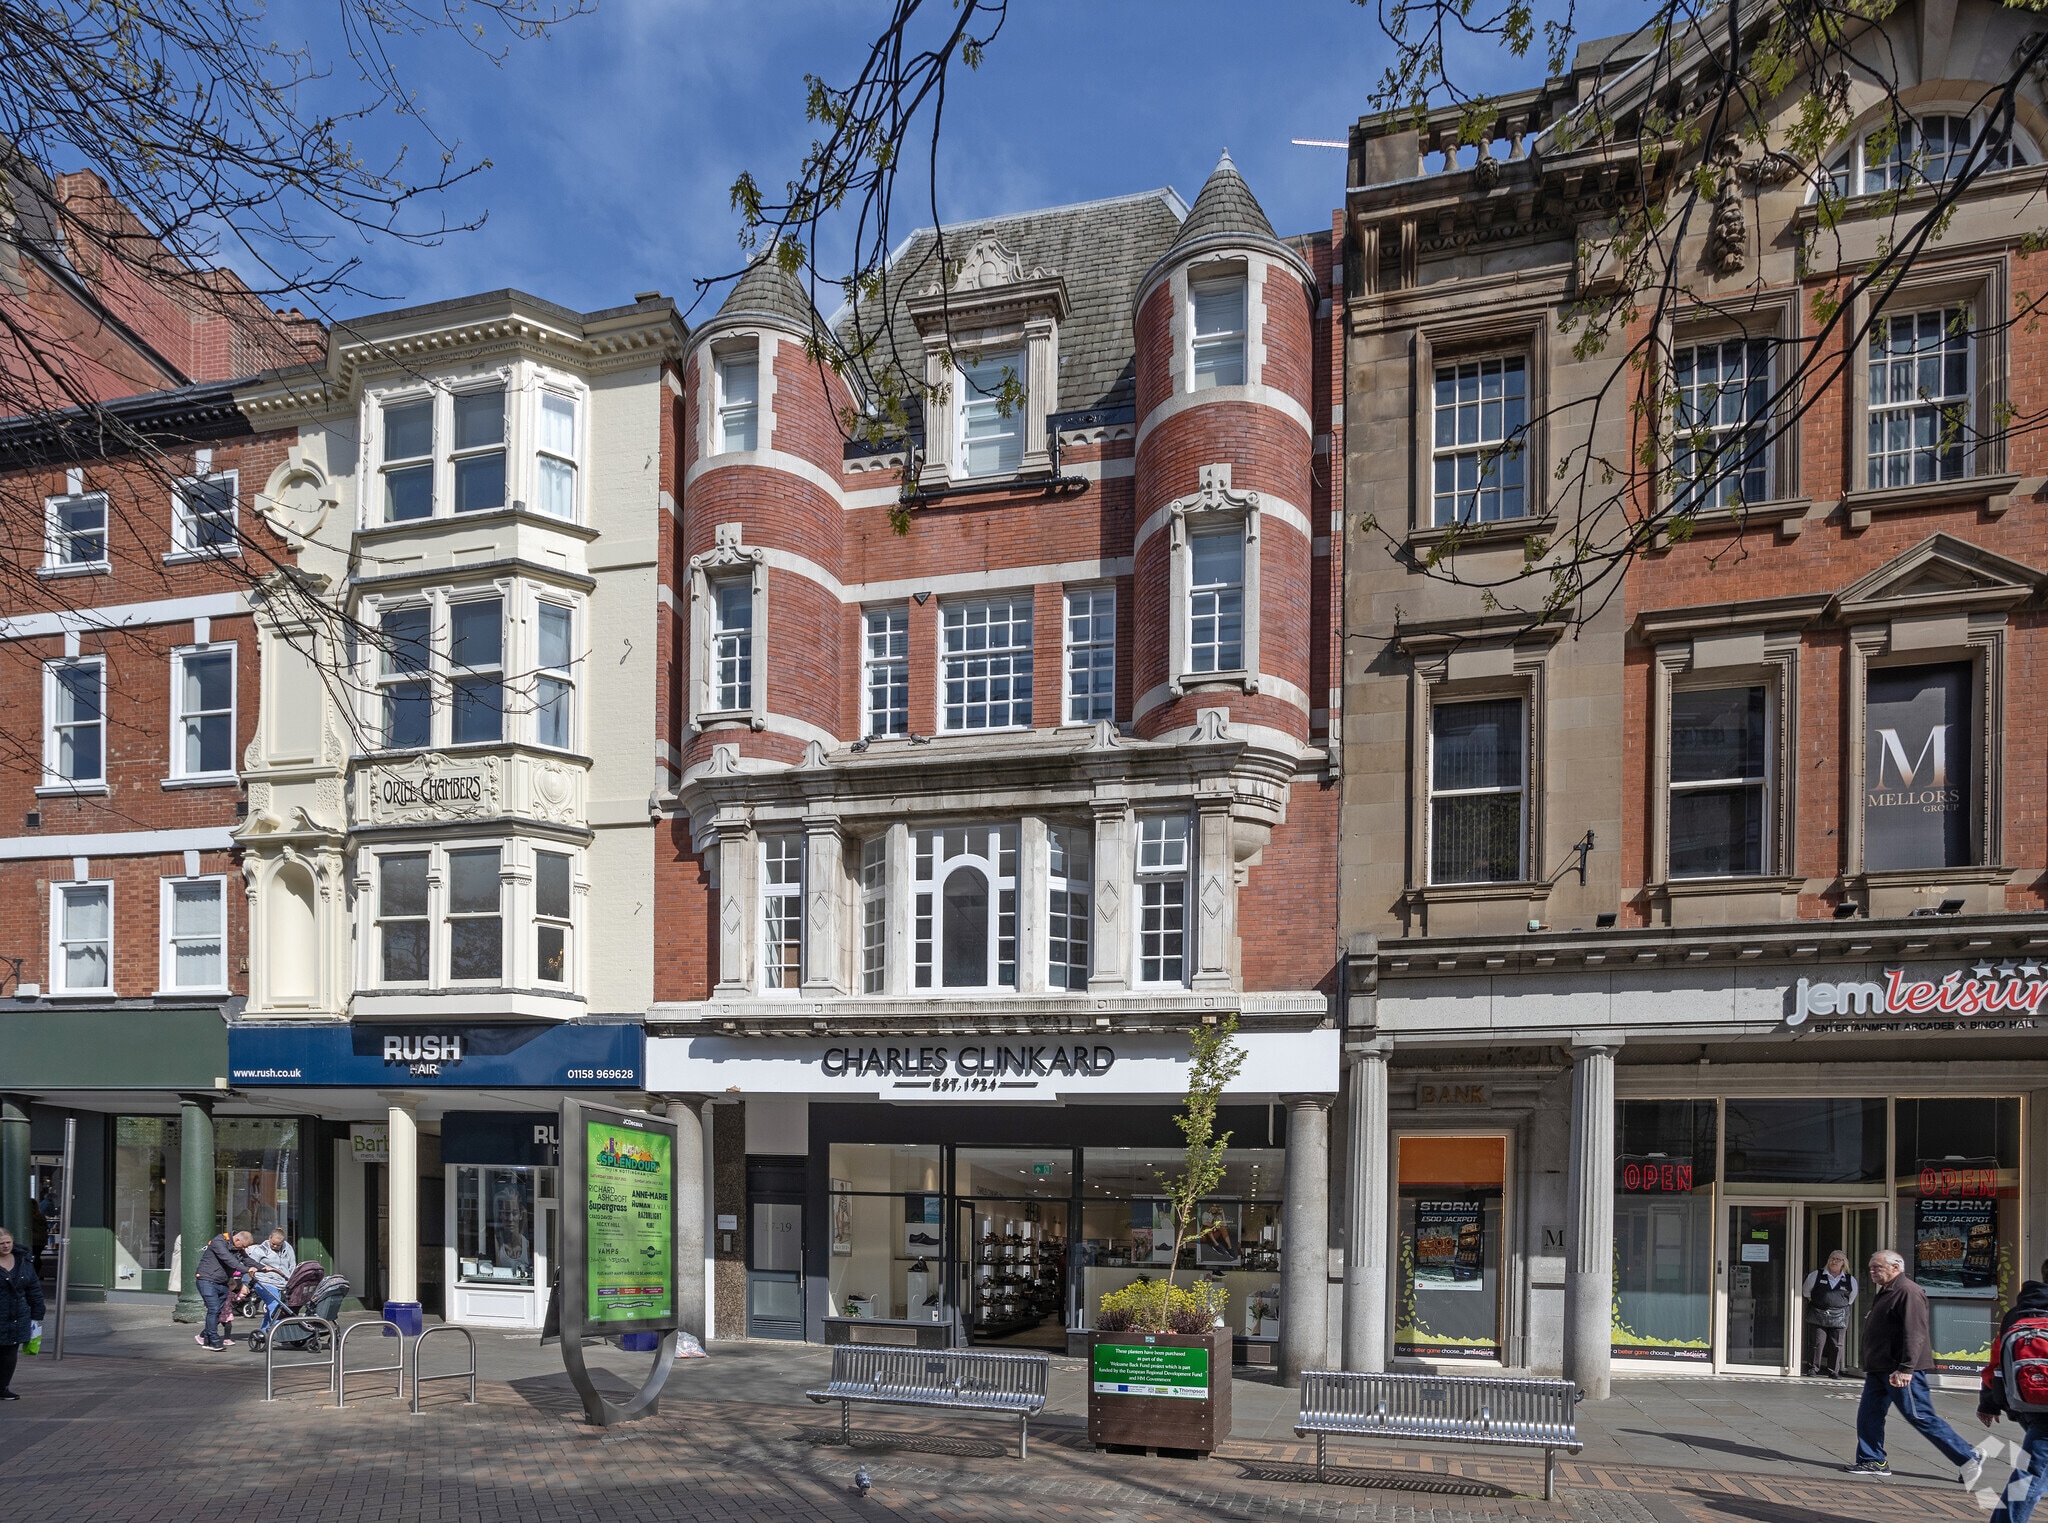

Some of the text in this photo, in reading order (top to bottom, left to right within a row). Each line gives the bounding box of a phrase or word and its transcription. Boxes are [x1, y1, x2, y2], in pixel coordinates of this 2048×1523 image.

[1870, 724, 1957, 791] M
[383, 776, 482, 806] ORIEL CHAMBERS
[1868, 789, 1960, 807] MELLORS
[1922, 803, 1960, 813] GROUP
[1815, 1020, 2039, 1033] ENTERTAINMENT ARCADES & BINGO HALL
[384, 1036, 460, 1060] RUSH
[822, 1046, 1116, 1073] CHARLES CLINKARD
[233, 1069, 302, 1079] www.rush.co.uk
[410, 1063, 441, 1075] HAIR
[567, 1069, 634, 1080] 01158 969628
[964, 1077, 997, 1092] 1924
[1421, 1085, 1487, 1104] BANK
[601, 1153, 657, 1172] SPLENDOUR
[1624, 1163, 1692, 1191] OPEN
[1919, 1167, 1997, 1196] OPEN
[588, 1184, 615, 1194] RICHARD
[597, 1193, 627, 1203] ASHCROFT
[632, 1190, 668, 1201] ANNE-MARIE
[588, 1200, 627, 1213] Supergrass
[632, 1200, 651, 1209] HUMAN
[1420, 1201, 1479, 1211] STORM
[1920, 1200, 1992, 1210] STORM
[638, 1211, 662, 1220] RAZORLIGHT
[1922, 1215, 1947, 1223] £500
[1545, 1229, 1565, 1247] M
[1920, 1250, 1962, 1261] GAMES
[1179, 1387, 1205, 1395] Thompson
